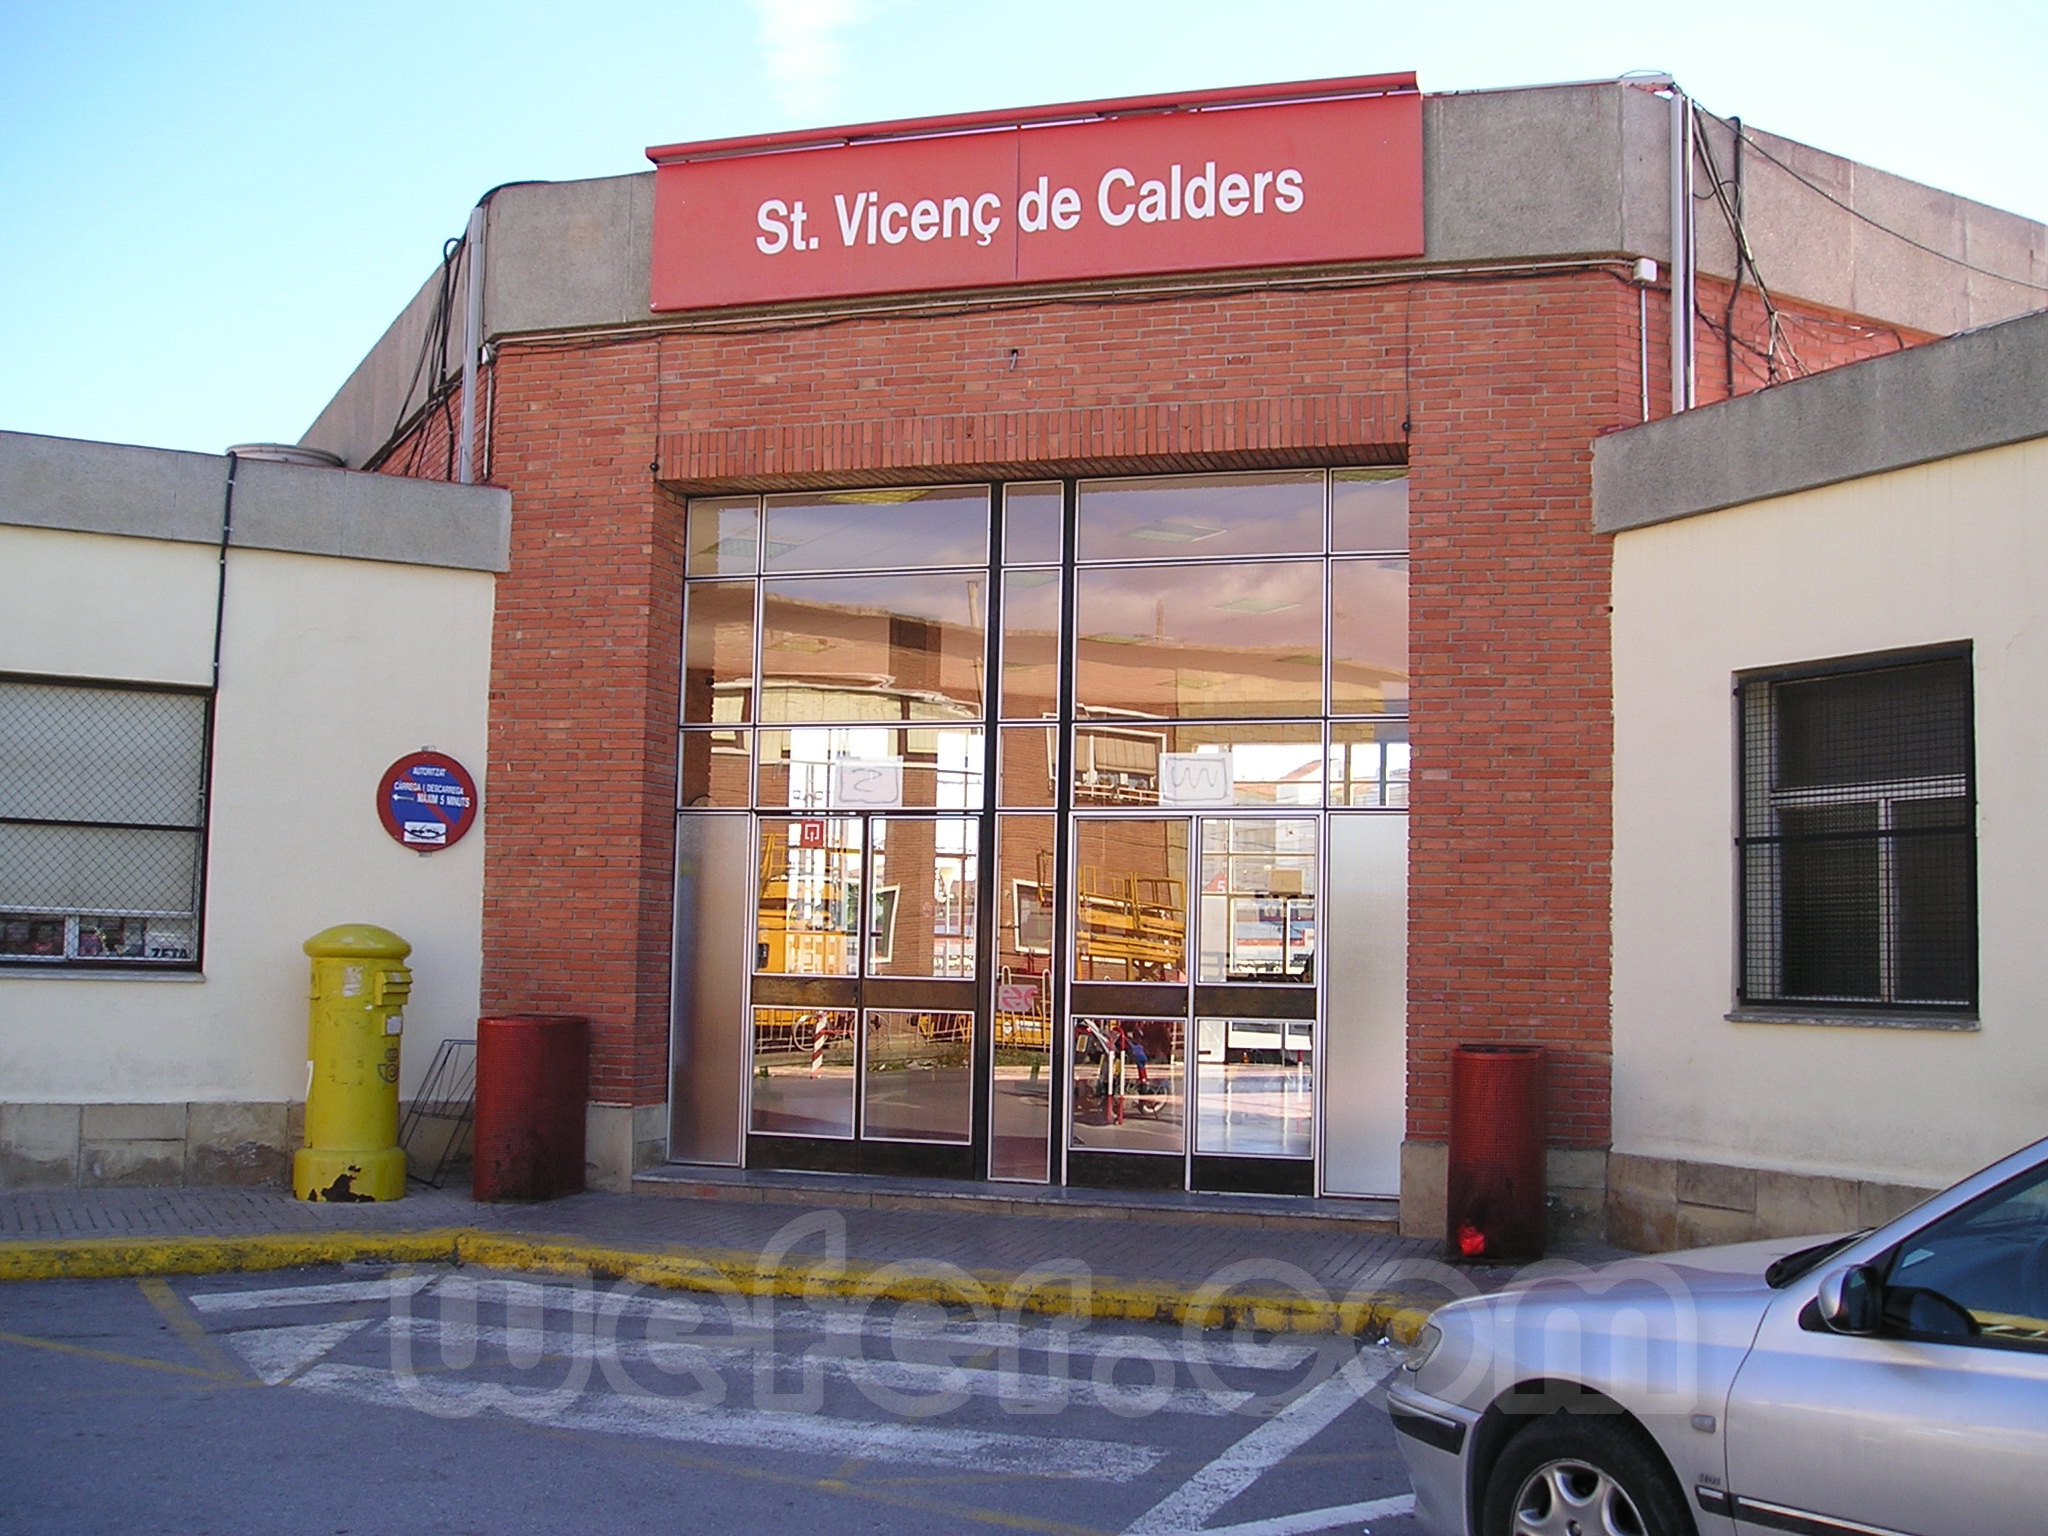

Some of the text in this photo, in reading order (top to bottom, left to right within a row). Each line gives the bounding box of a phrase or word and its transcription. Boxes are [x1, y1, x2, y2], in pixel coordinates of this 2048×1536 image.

[755, 161, 1304, 255] St. Vicenç de Calders
[413, 767, 446, 777] AUTORITZAT
[440, 795, 445, 805] 5
[446, 796, 470, 807] MINUTS
